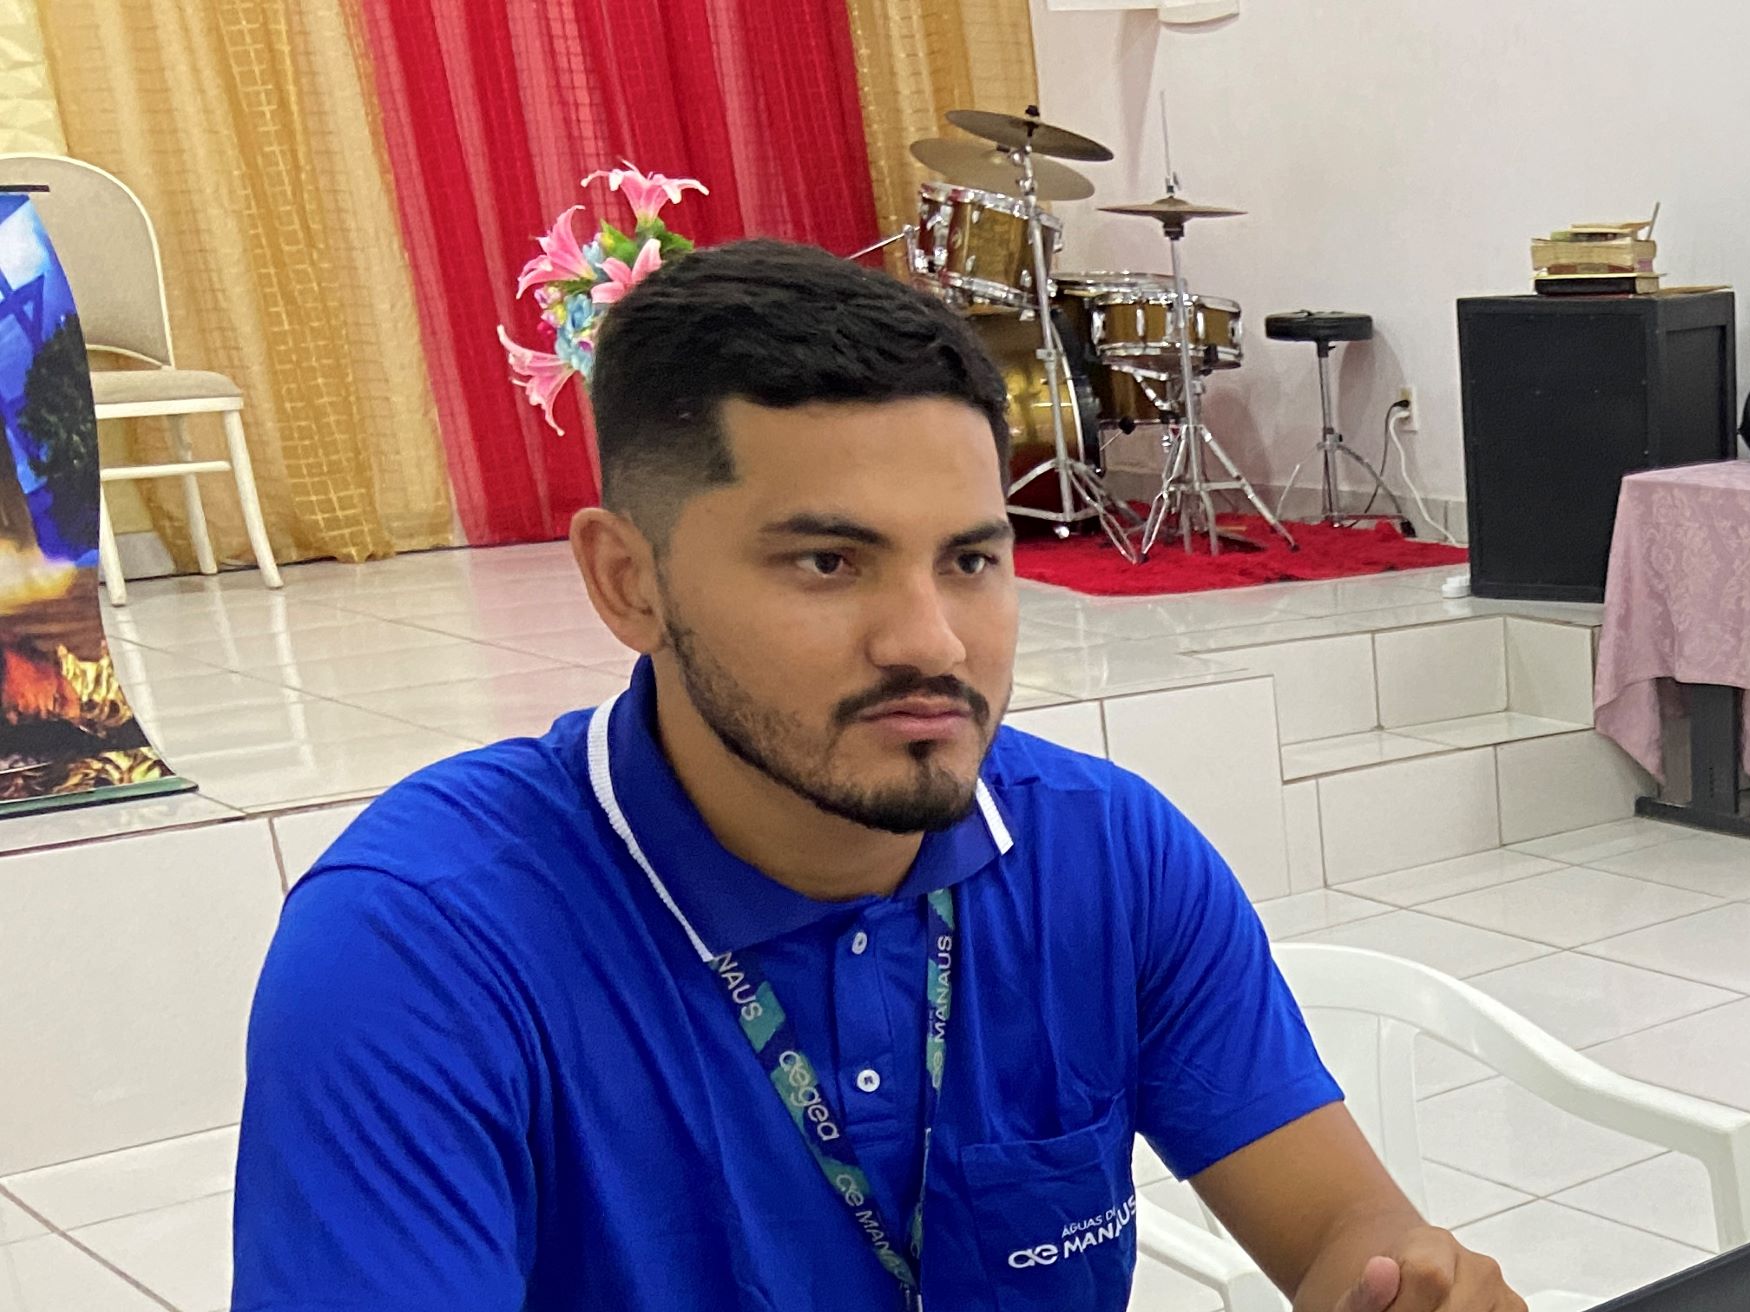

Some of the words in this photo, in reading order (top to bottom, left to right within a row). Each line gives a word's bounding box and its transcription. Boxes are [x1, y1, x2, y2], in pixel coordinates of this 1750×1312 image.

[713, 952, 763, 1021] NAUS
[935, 935, 952, 1042] MANAUS
[779, 1051, 840, 1142] aegea
